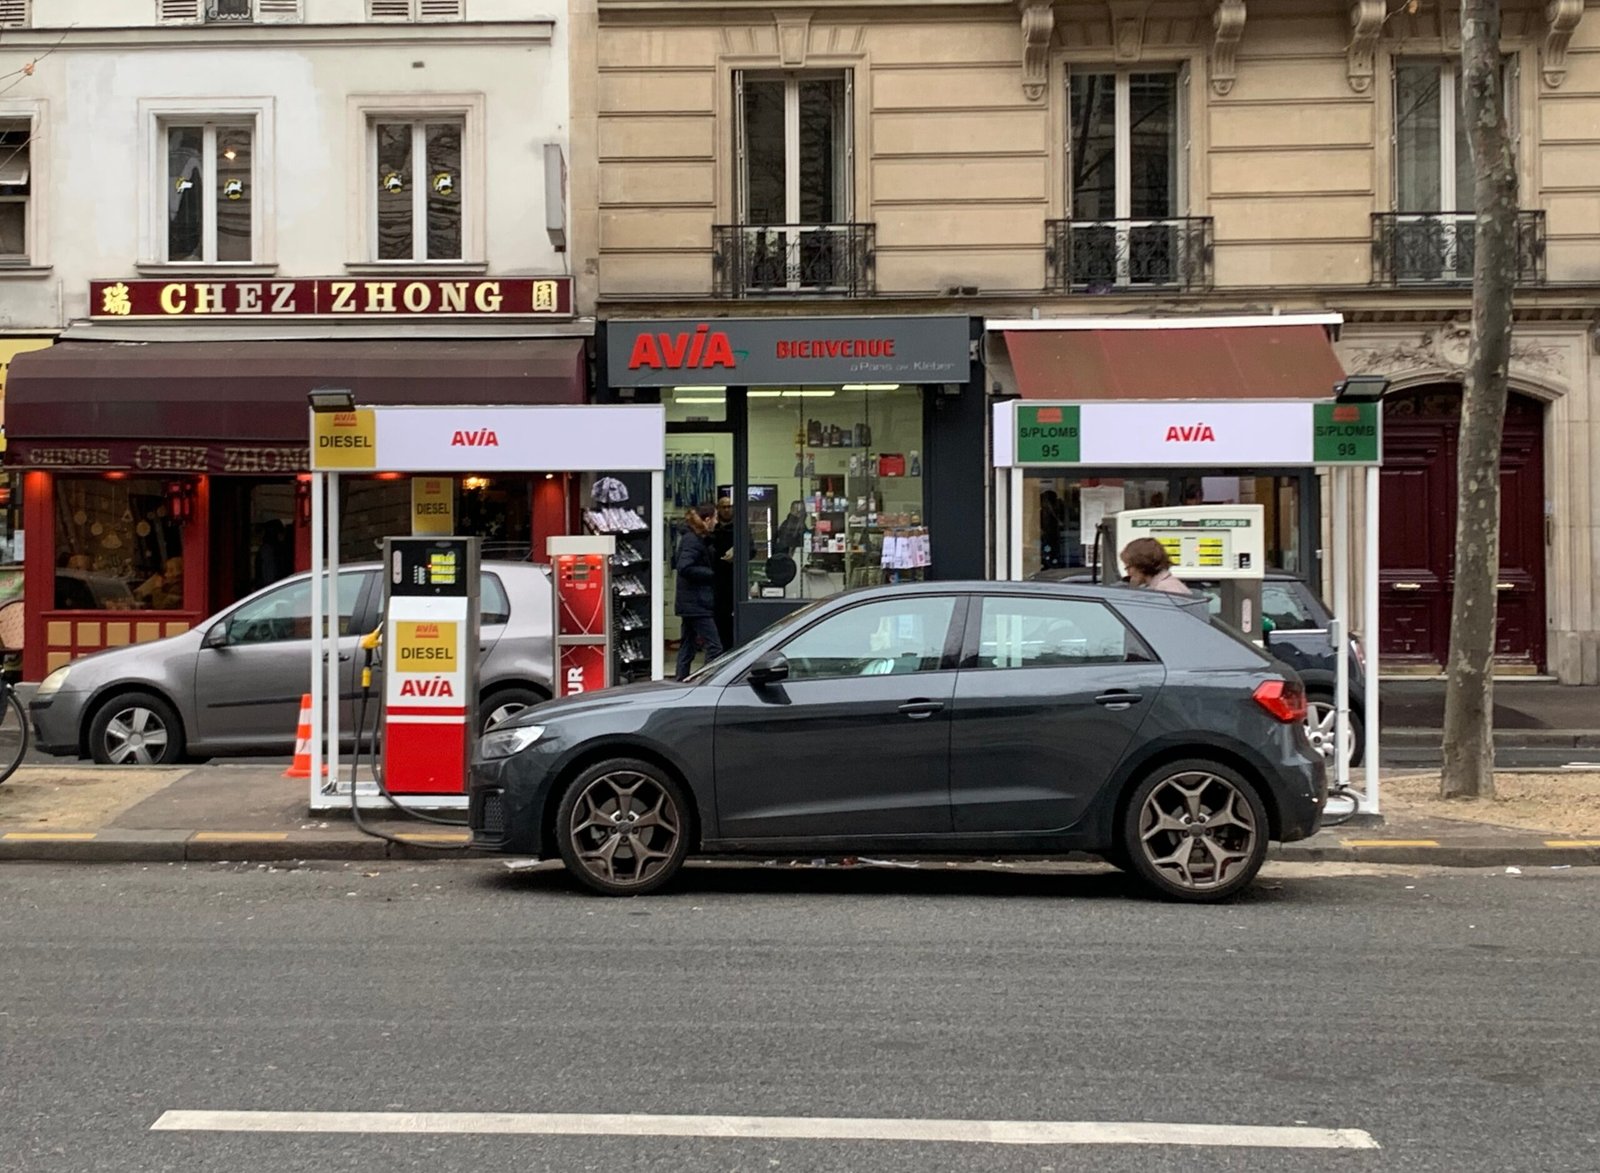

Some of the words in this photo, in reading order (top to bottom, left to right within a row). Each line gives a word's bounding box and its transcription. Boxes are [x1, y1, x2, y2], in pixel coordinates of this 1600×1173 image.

[160, 283, 296, 314] CHEZ
[331, 282, 503, 313] ZHONG
[776, 339, 896, 360] BIENVENUE
[1020, 426, 1078, 438] S/PLOMB
[1316, 425, 1375, 437] S/PLOMB
[319, 435, 372, 448] DIESEL
[1042, 444, 1060, 457] 95
[1338, 443, 1356, 456] 98
[29, 448, 110, 465] CHINOIS
[135, 445, 208, 471] CHEZ
[416, 503, 450, 515] DIESEL
[401, 647, 454, 660] DIESEL
